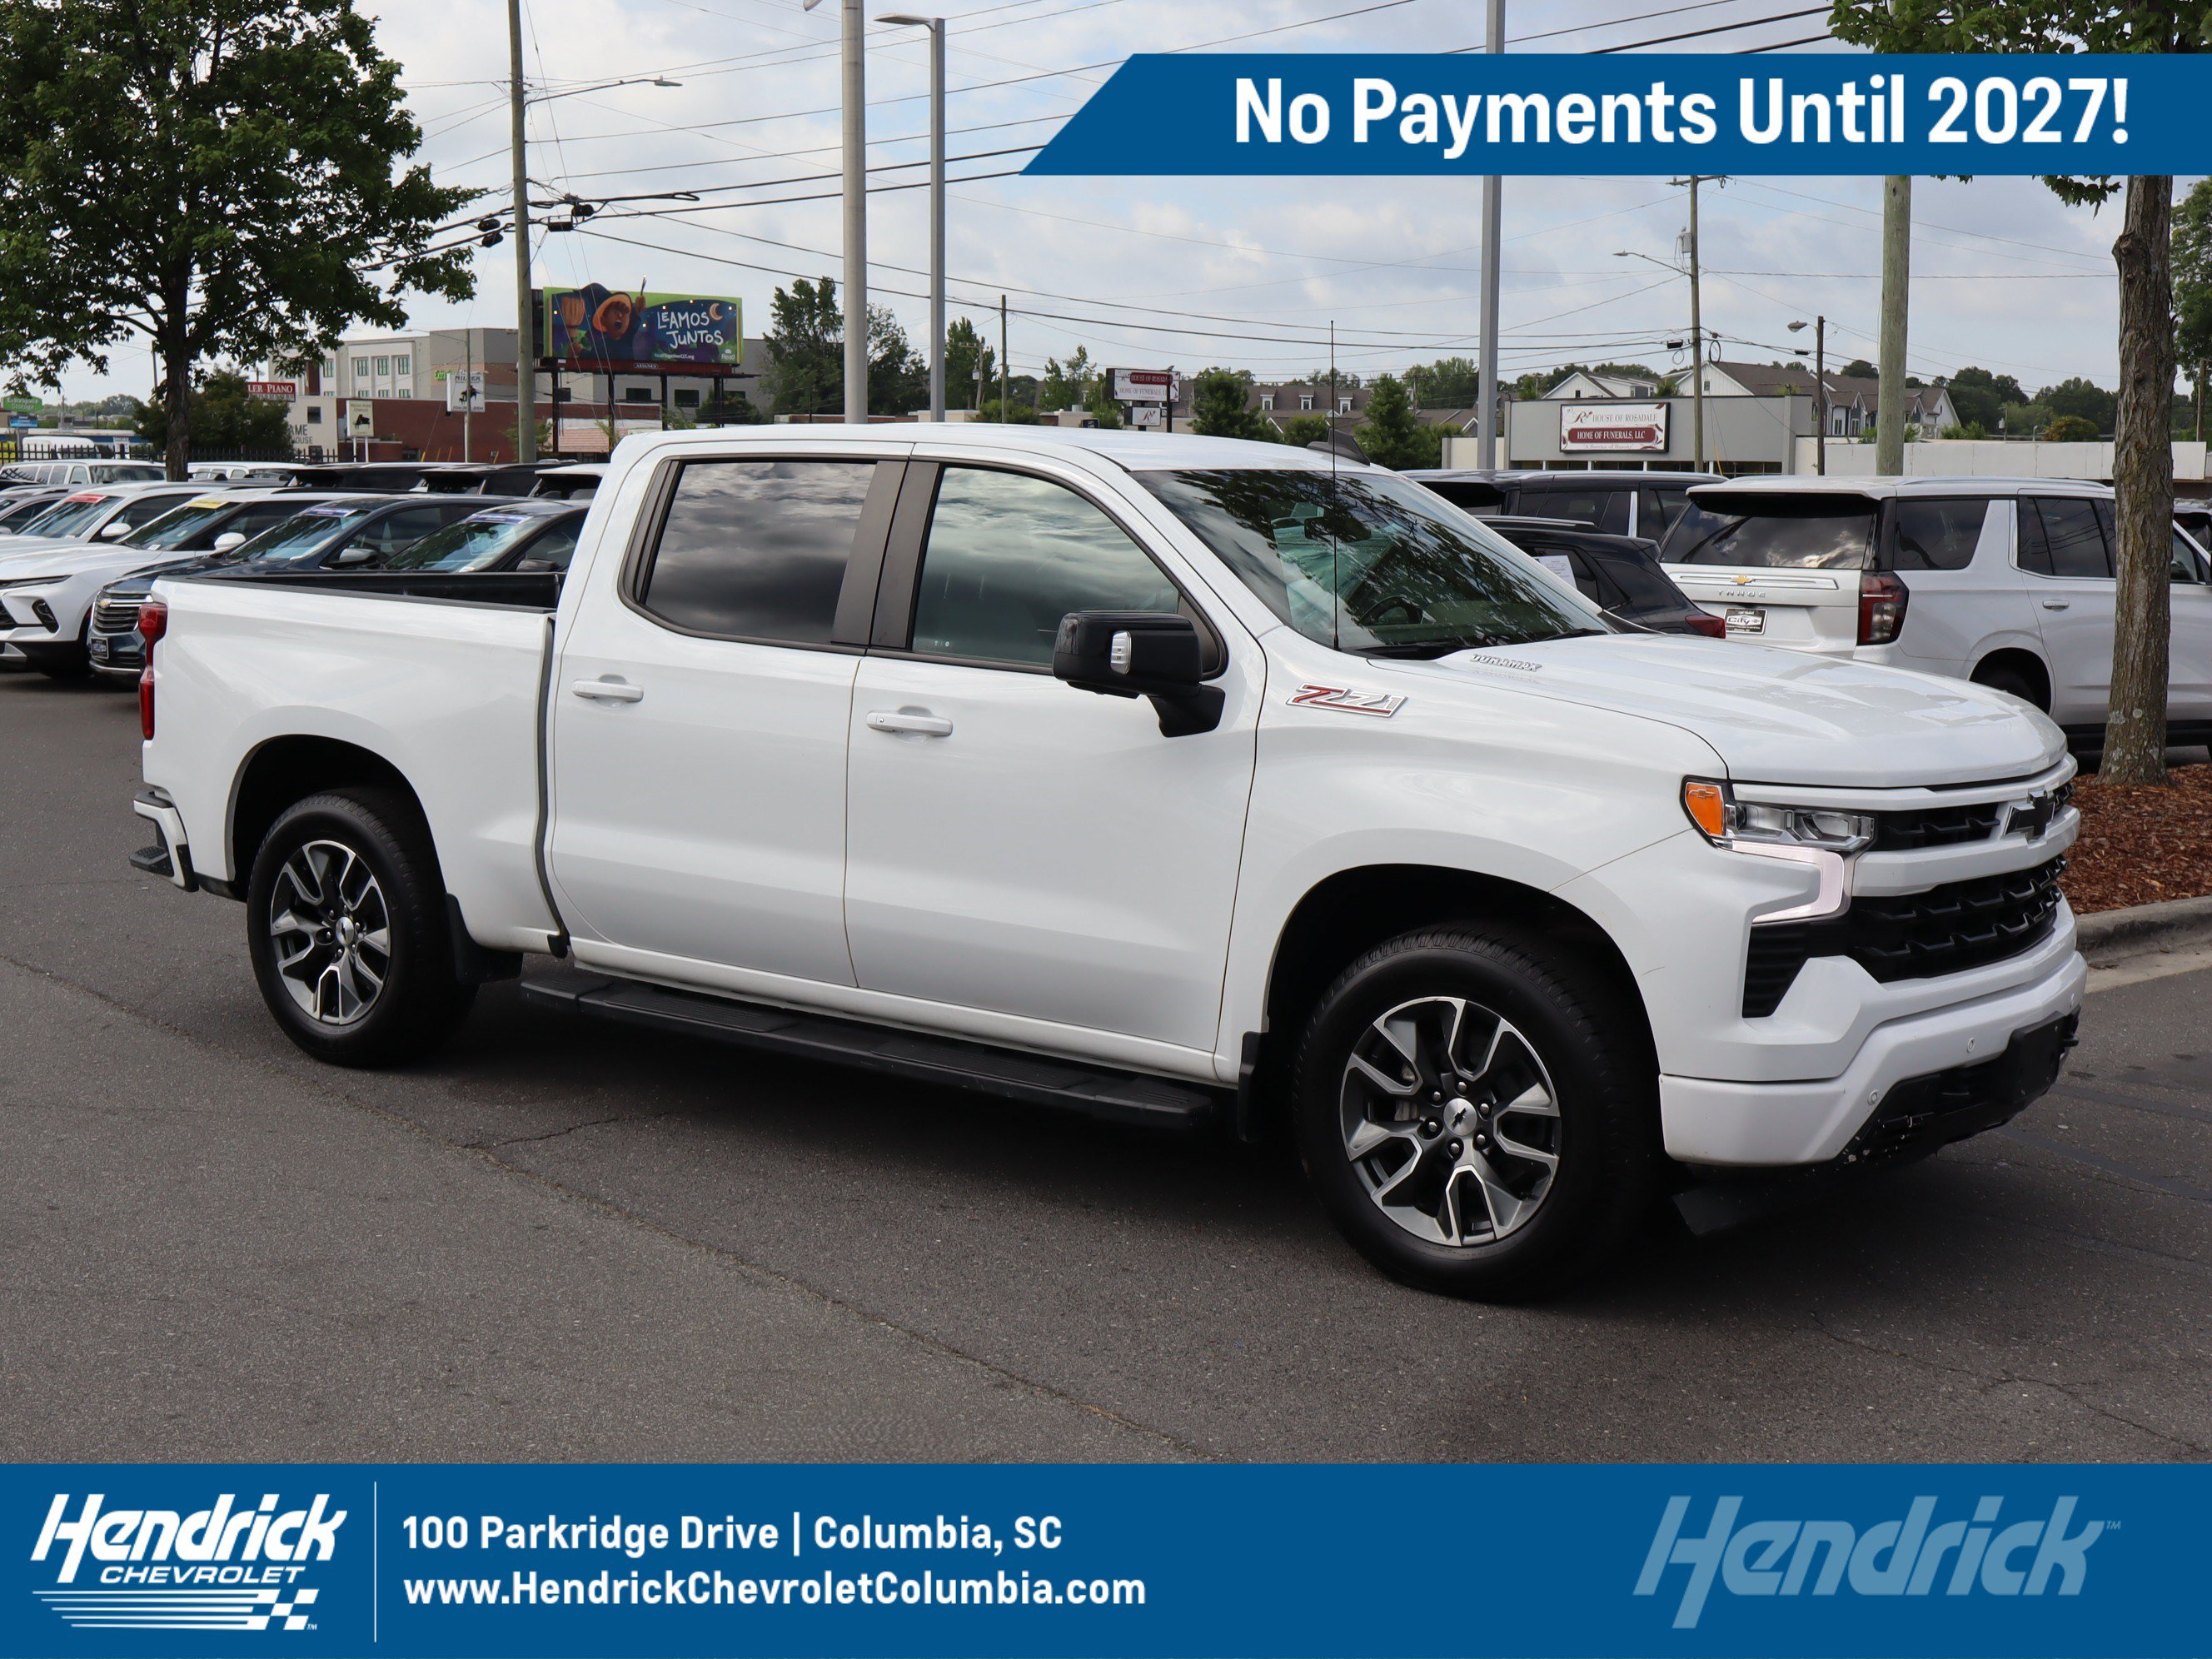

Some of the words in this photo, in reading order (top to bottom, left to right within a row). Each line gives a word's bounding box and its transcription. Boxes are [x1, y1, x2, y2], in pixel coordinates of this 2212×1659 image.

[657, 311, 710, 329] LEAMOS
[267, 384, 293, 393] PIANO
[1592, 414, 1613, 423] HOUSE
[1615, 414, 1623, 422] OF
[1625, 413, 1657, 422] ROSADALE
[1577, 431, 1594, 440] HOME
[1603, 431, 1634, 440] FUNERALS,
[1635, 431, 1646, 439] LLC
[1470, 654, 1542, 672] DURAMAX
[1285, 682, 1409, 718] Z71
